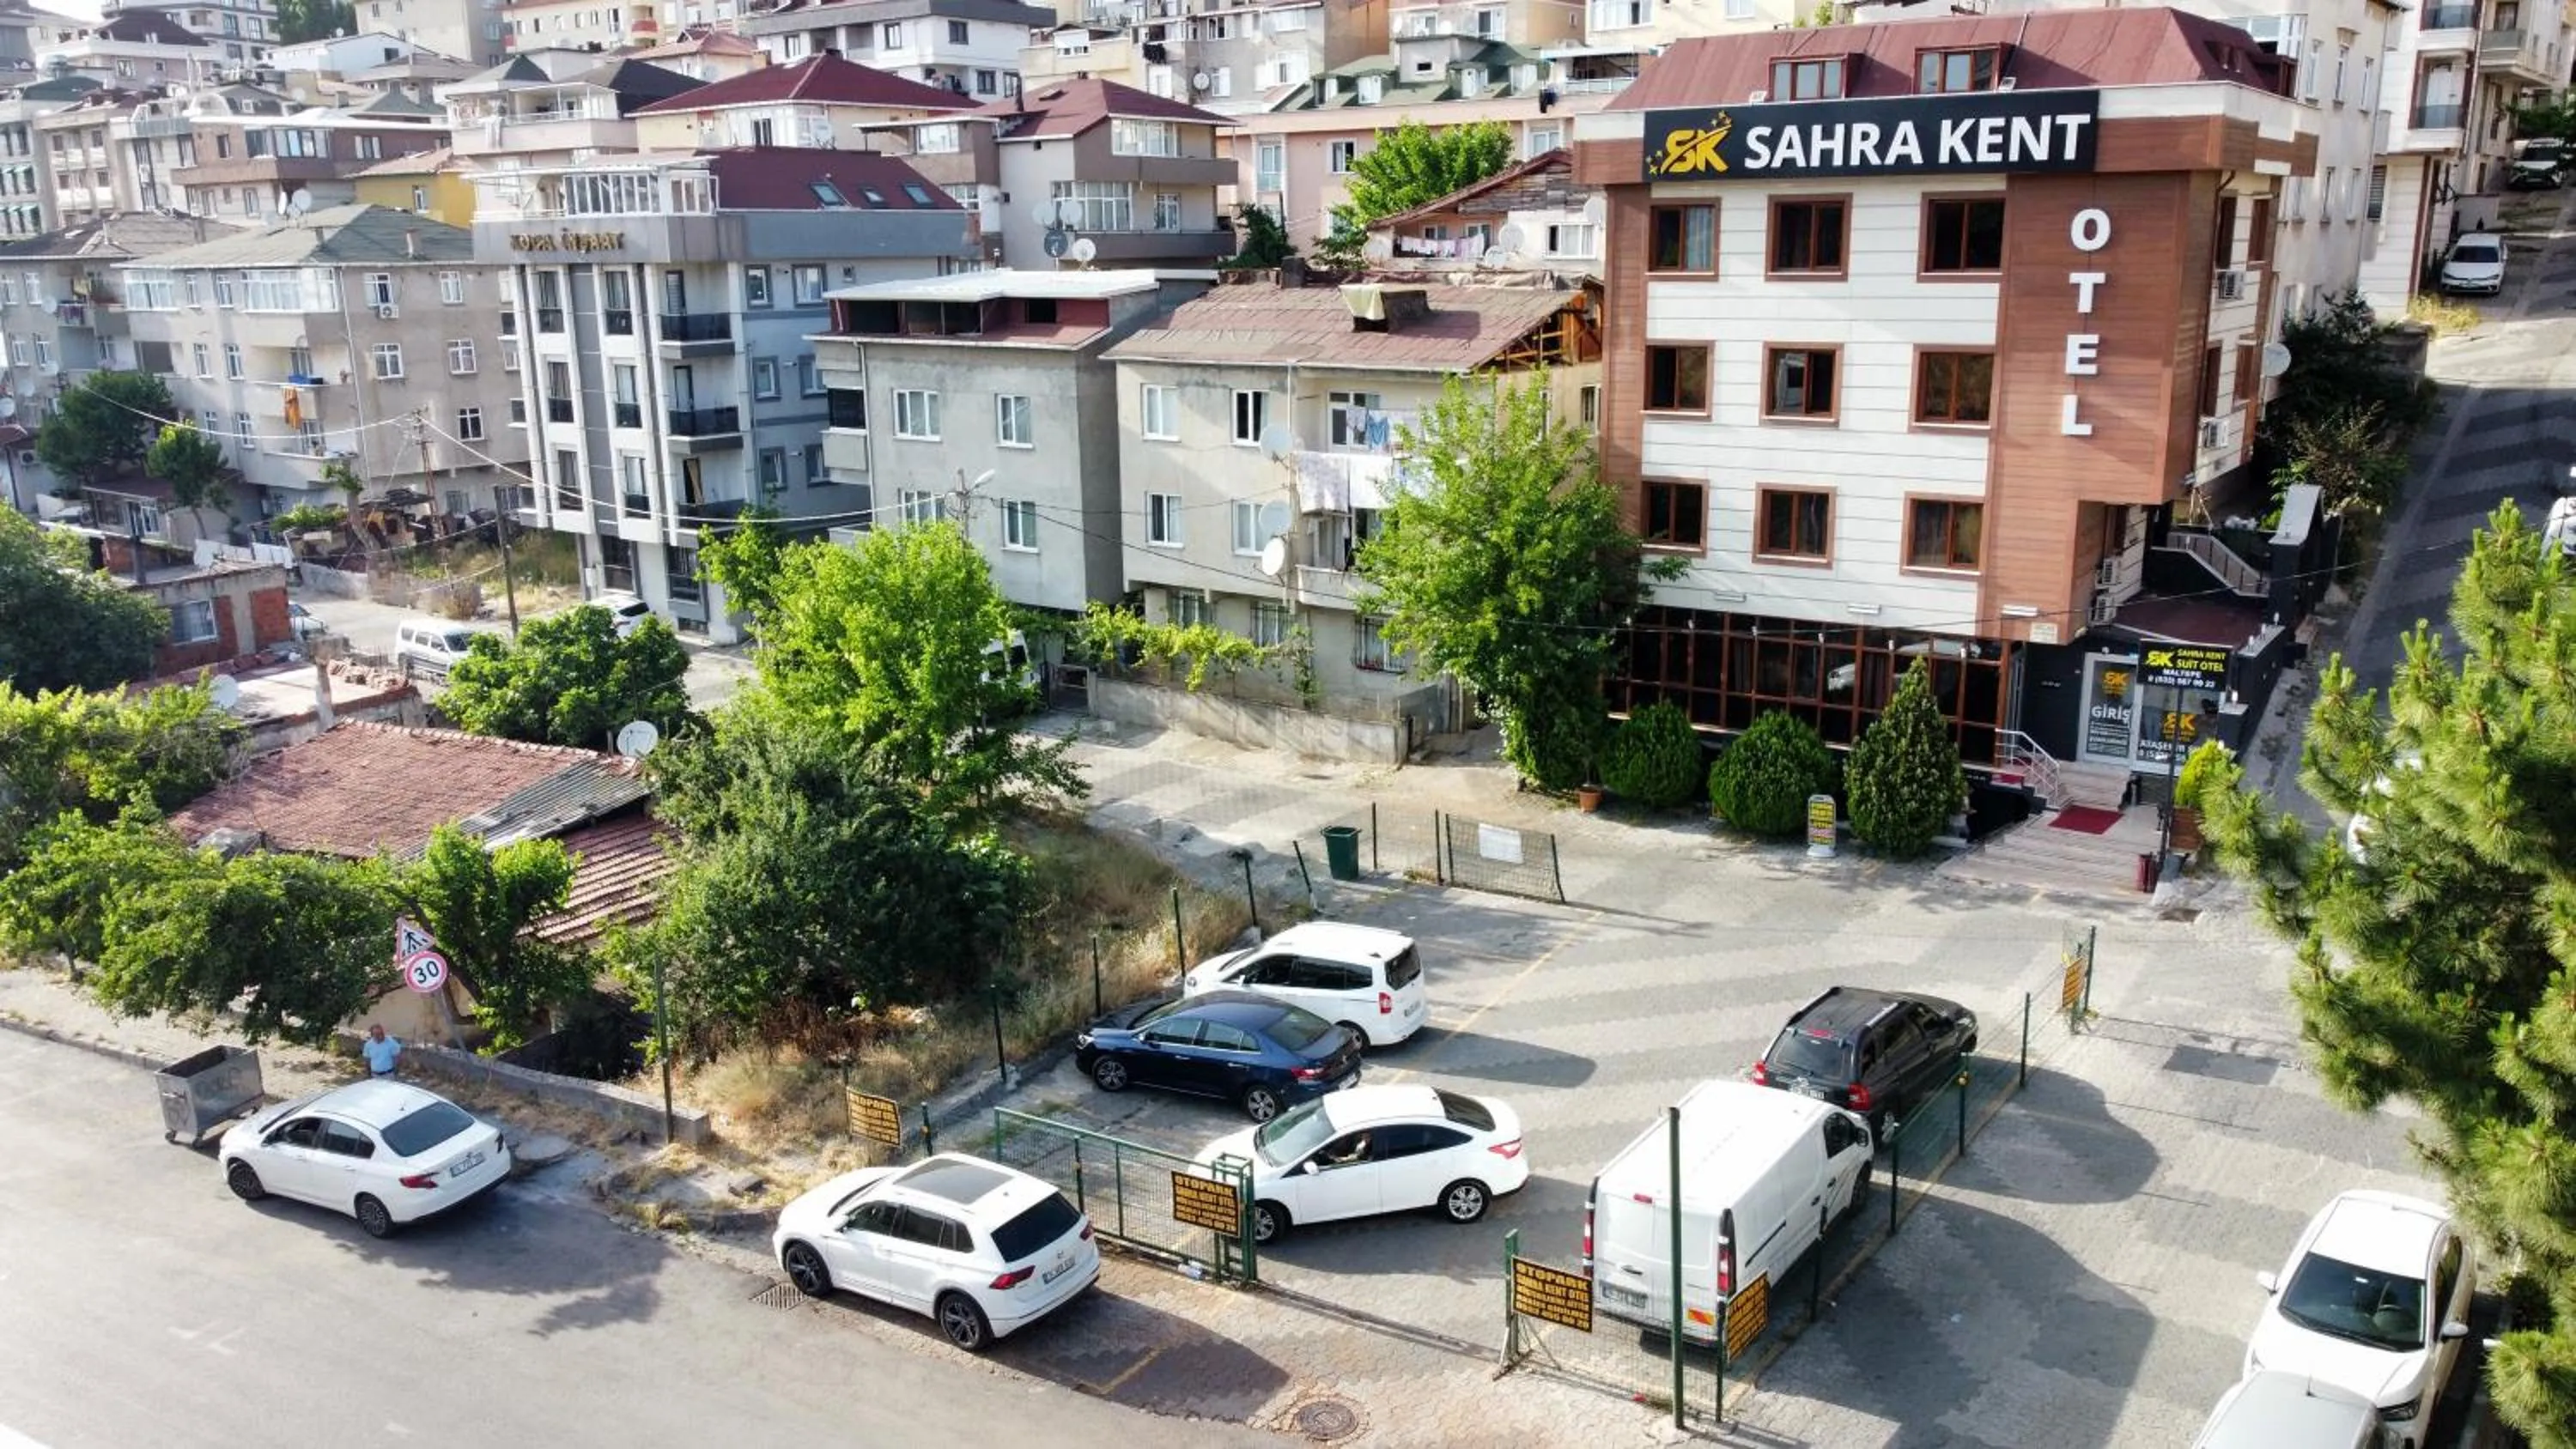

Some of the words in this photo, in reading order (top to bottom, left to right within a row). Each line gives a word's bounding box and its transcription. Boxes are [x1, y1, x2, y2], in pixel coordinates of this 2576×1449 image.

[1661, 124, 1733, 173] SK
[1744, 119, 1924, 169] SAHRA
[1938, 113, 2091, 165] KENT
[2061, 208, 2112, 436] OTEL
[2199, 662, 2225, 672] OTEL
[2091, 704, 2131, 724] GİRİŞ
[414, 961, 440, 984] 30
[1175, 1175, 1235, 1197] OTOPARK
[1516, 1262, 1588, 1290] OTOPARK
[1545, 1282, 1567, 1297] KENT
